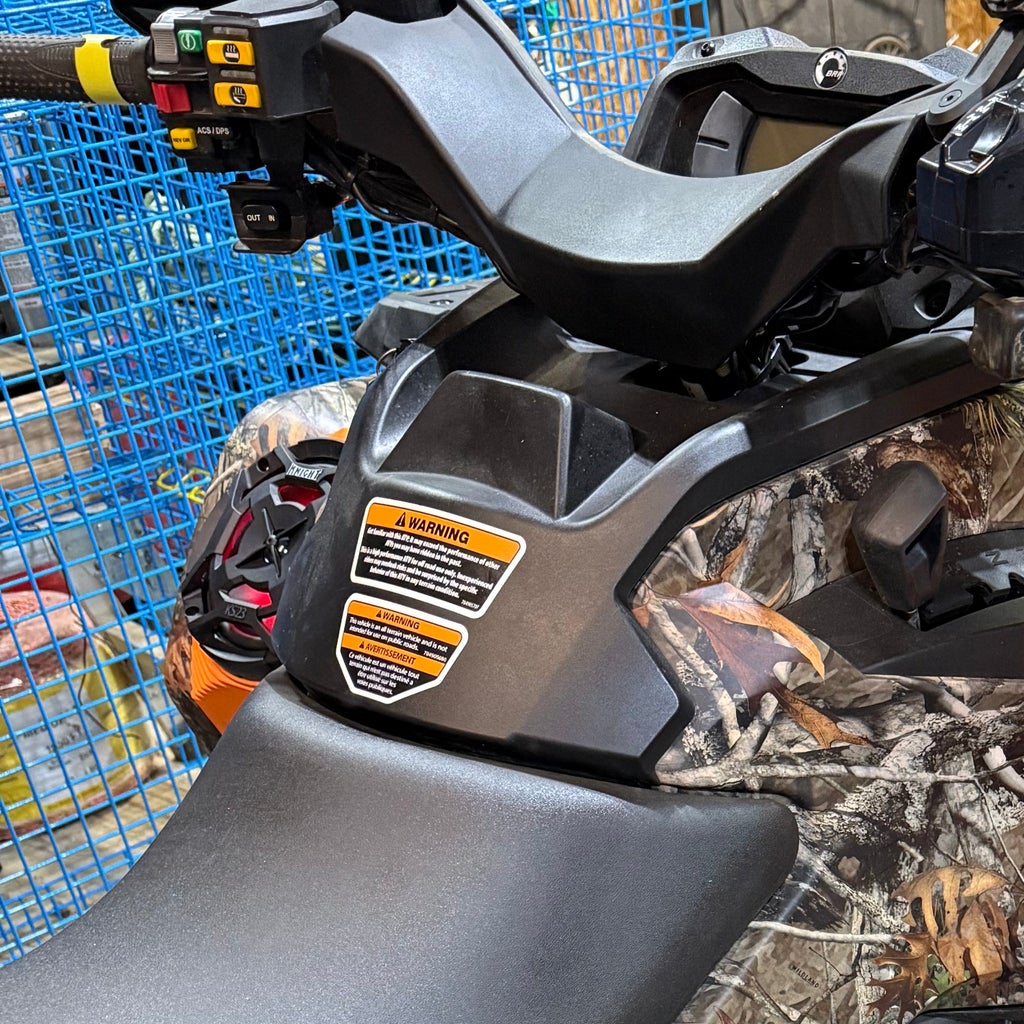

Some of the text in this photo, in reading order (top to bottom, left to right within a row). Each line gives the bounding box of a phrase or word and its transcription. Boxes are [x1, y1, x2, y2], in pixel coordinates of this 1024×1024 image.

[197, 126, 211, 134] ACS
[215, 127, 230, 135] DPS
[246, 214, 261, 222] OUT
[286, 462, 324, 482] KNIGHT
[408, 516, 469, 544] WARNING
[371, 548, 380, 557] high
[402, 555, 412, 563] ATV
[410, 557, 418, 565] for
[424, 562, 436, 570] road
[400, 544, 410, 552] may
[409, 545, 420, 554] have
[419, 548, 435, 558] ridden
[440, 554, 449, 563] the
[448, 558, 461, 567] past.
[413, 538, 423, 546] may
[422, 541, 439, 550] exceed
[438, 544, 447, 552] the
[446, 548, 479, 563] performance
[484, 560, 500, 570] other
[389, 570, 397, 578] this
[396, 572, 406, 580] ATV
[409, 577, 419, 586] any
[418, 579, 435, 589] terrain
[406, 566, 416, 574] and
[420, 571, 444, 582] surprised
[449, 579, 459, 588] the
[458, 583, 478, 594] specific
[224, 605, 248, 620] KS23
[383, 612, 419, 629] WARNING
[349, 616, 357, 624] This
[386, 627, 402, 637] terrain
[402, 633, 421, 643] vehicle
[420, 639, 432, 647] and
[437, 644, 448, 652] not
[349, 625, 367, 634] intended
[386, 636, 403, 645] public
[402, 641, 418, 650] roads.
[348, 660, 362, 668] terrain
[366, 644, 415, 664] AVERTISSEMENT
[388, 679, 396, 687] les
[407, 670, 419, 679] tout
